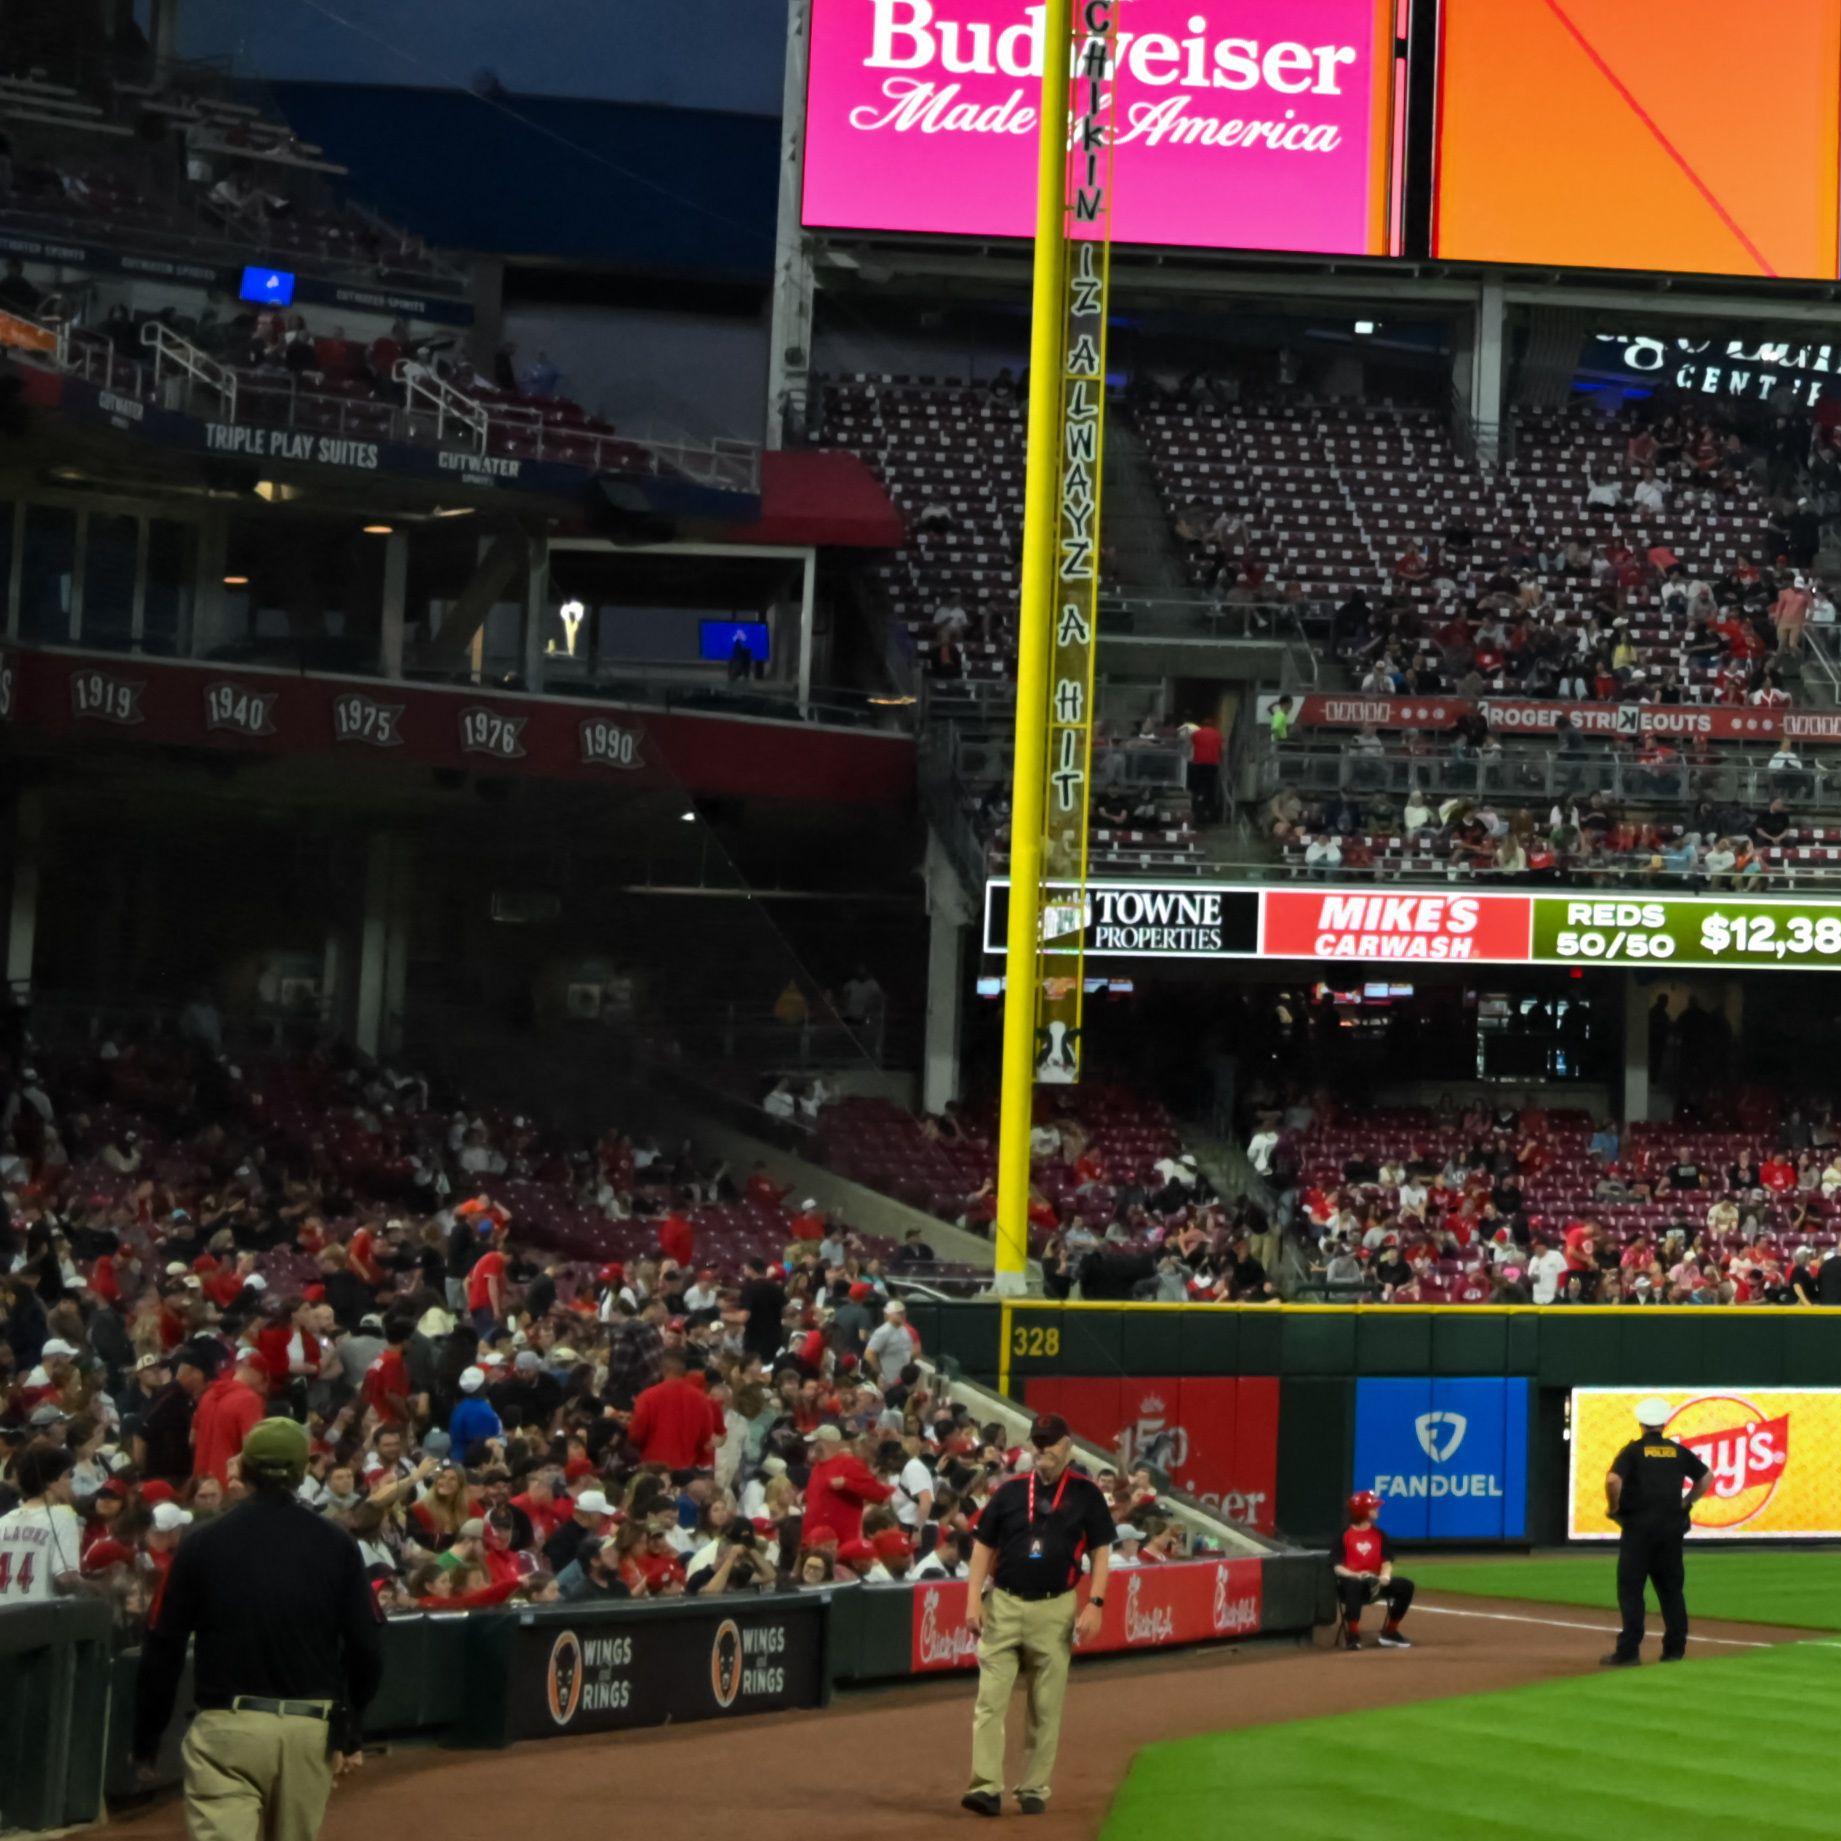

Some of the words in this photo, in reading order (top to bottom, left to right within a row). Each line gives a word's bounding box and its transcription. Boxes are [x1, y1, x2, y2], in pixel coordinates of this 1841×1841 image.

[850, 77, 1037, 135] Made
[1122, 95, 1341, 152] America
[1072, 244, 1101, 314] IZ
[205, 423, 264, 454] TRIPLE
[270, 432, 313, 461] PLAY
[318, 438, 378, 470] SUITES
[1061, 334, 1100, 580] ALWAYZ
[1058, 605, 1089, 648] A
[77, 678, 132, 718] 1919
[209, 687, 264, 730] 1940
[1478, 703, 1563, 728] ROGER
[338, 699, 391, 741] 1975
[465, 713, 516, 754] 1976
[583, 726, 633, 764] 1990
[1052, 679, 1084, 812] HIT
[1095, 891, 1222, 925] TOWNE
[1318, 894, 1479, 933] MIKE'S
[1567, 903, 1665, 928] REDS
[1095, 925, 1222, 951] PROPERTIES
[1314, 933, 1474, 958] CARWASH
[1556, 933, 1676, 958] 50/50
[1014, 1327, 1059, 1357] 328
[1644, 1446, 1677, 1458] POLICE
[1675, 1422, 1774, 1498] ay's
[1375, 1474, 1502, 1498] FANDUEL
[584, 1637, 632, 1666] WINGS
[742, 1627, 785, 1654] WINGS
[582, 1681, 629, 1710] RINGS
[742, 1668, 784, 1694] RINGS
